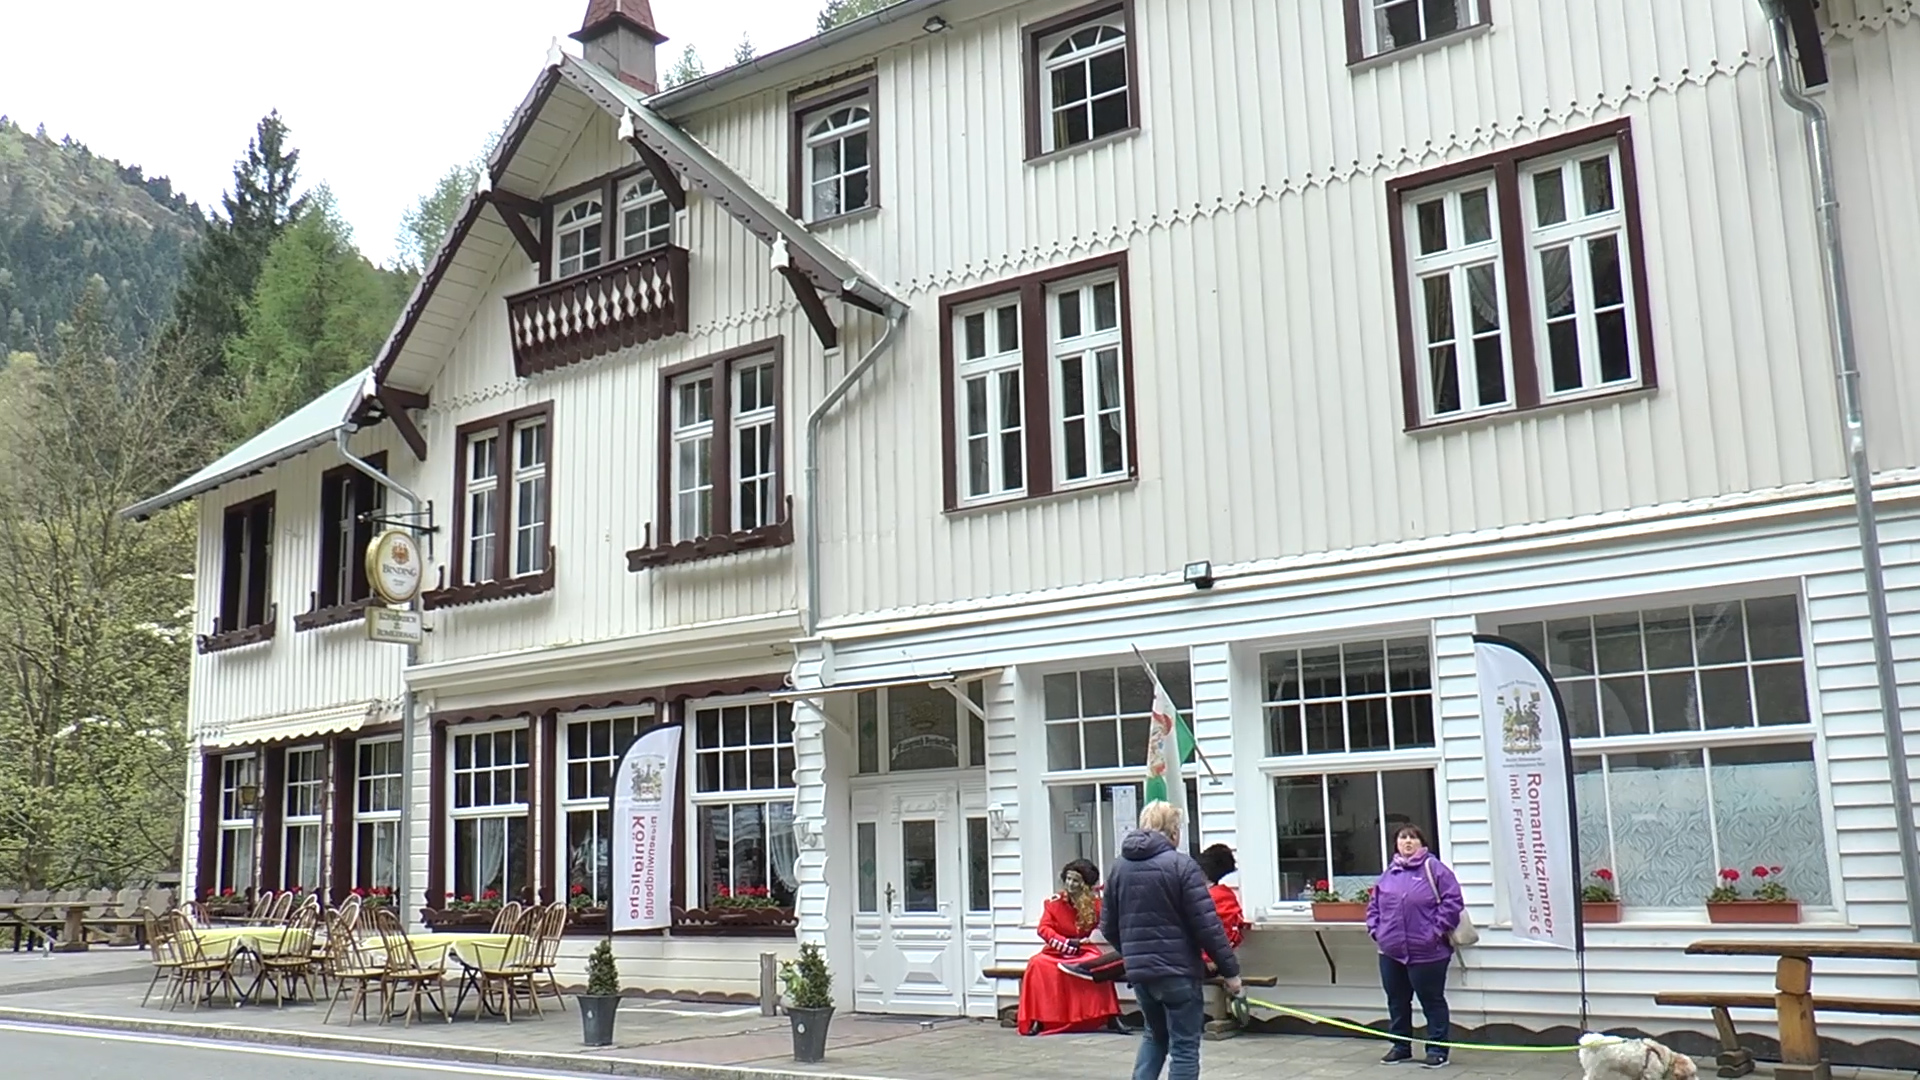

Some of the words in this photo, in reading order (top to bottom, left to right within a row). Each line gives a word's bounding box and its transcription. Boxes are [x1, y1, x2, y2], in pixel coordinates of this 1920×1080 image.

[382, 564, 417, 577] BINDING
[1508, 774, 1521, 804] inkl.
[1512, 808, 1531, 880] Frühstück
[1527, 773, 1556, 938] Romantikzimmer
[1525, 884, 1535, 902] ab
[1528, 905, 1539, 922] 35
